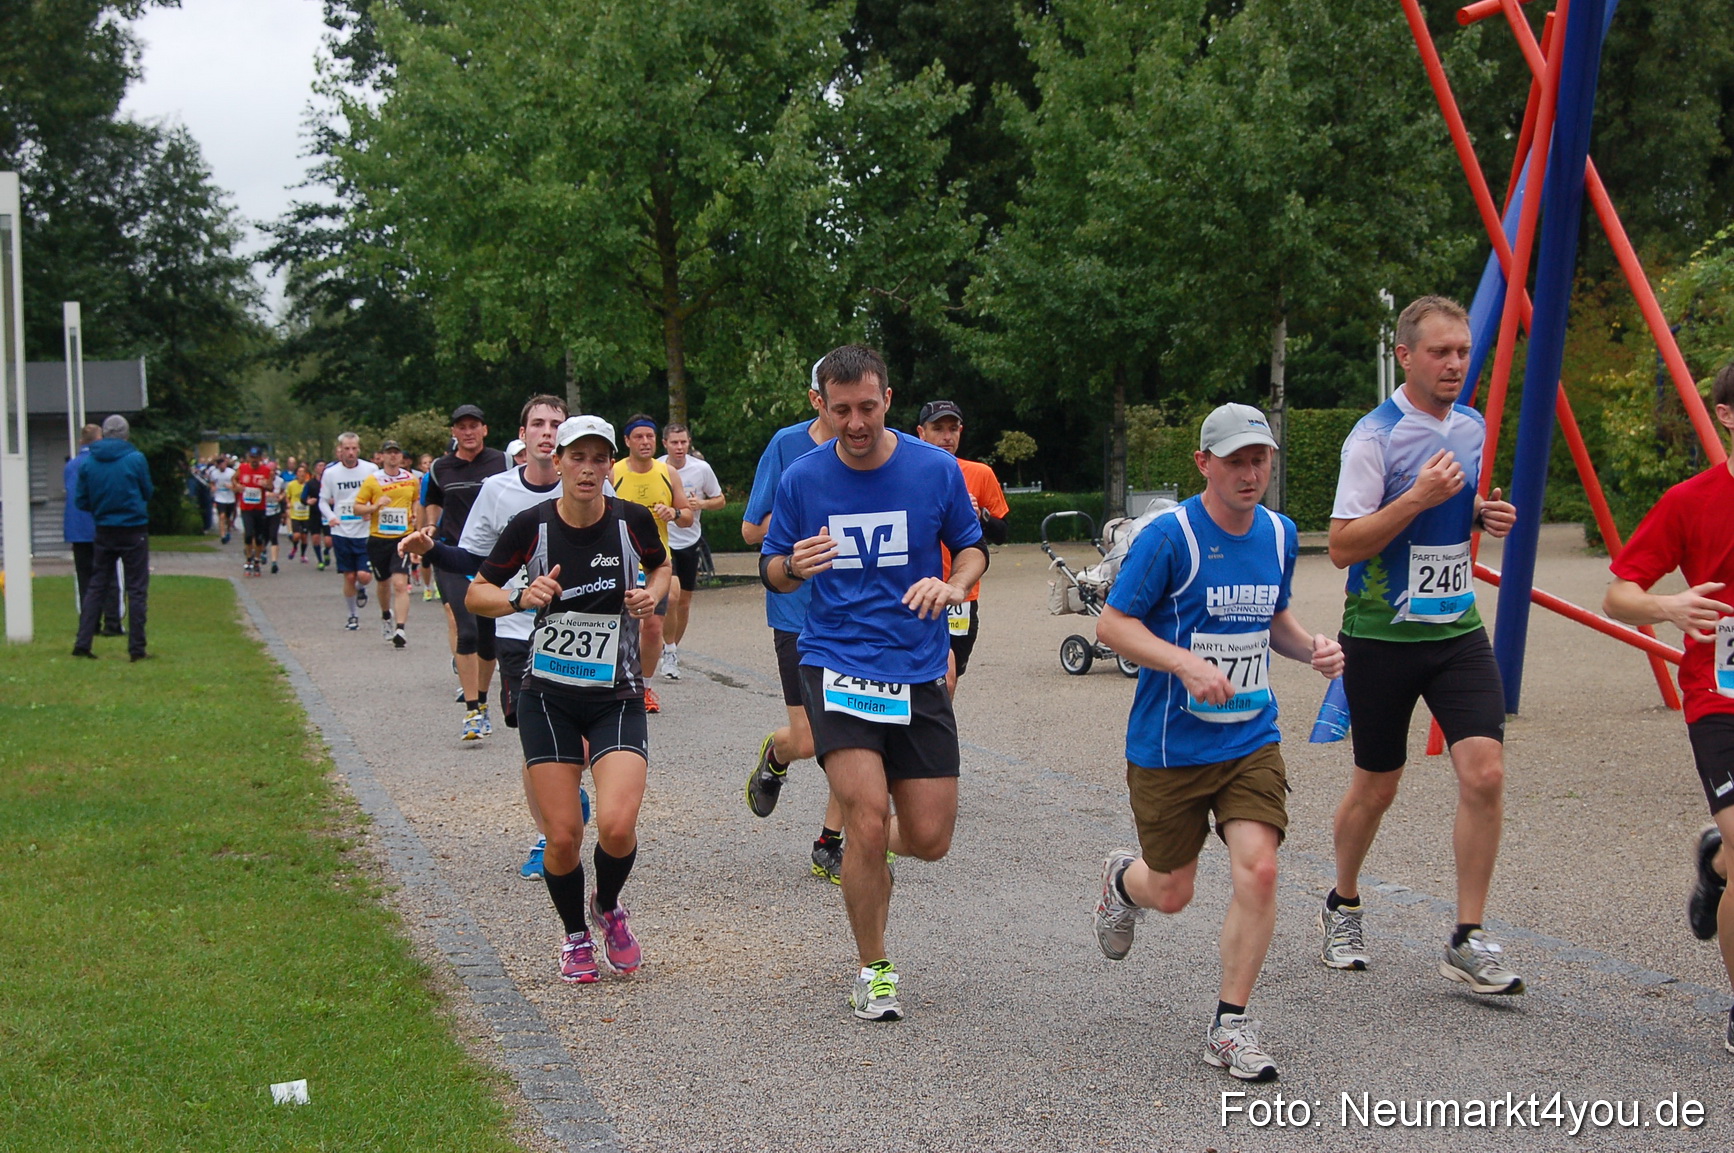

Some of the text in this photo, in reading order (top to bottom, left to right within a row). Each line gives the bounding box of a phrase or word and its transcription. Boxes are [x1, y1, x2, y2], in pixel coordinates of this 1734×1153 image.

[381, 514, 404, 524] 3041
[1412, 553, 1440, 561] PARTL
[1418, 561, 1468, 593] 2467
[1207, 585, 1279, 606] HUBER
[566, 619, 605, 628] Neumarkt
[543, 626, 611, 659] 2237
[1193, 642, 1226, 652] PARTL
[549, 660, 596, 677] Christine
[847, 697, 886, 713] Florian
